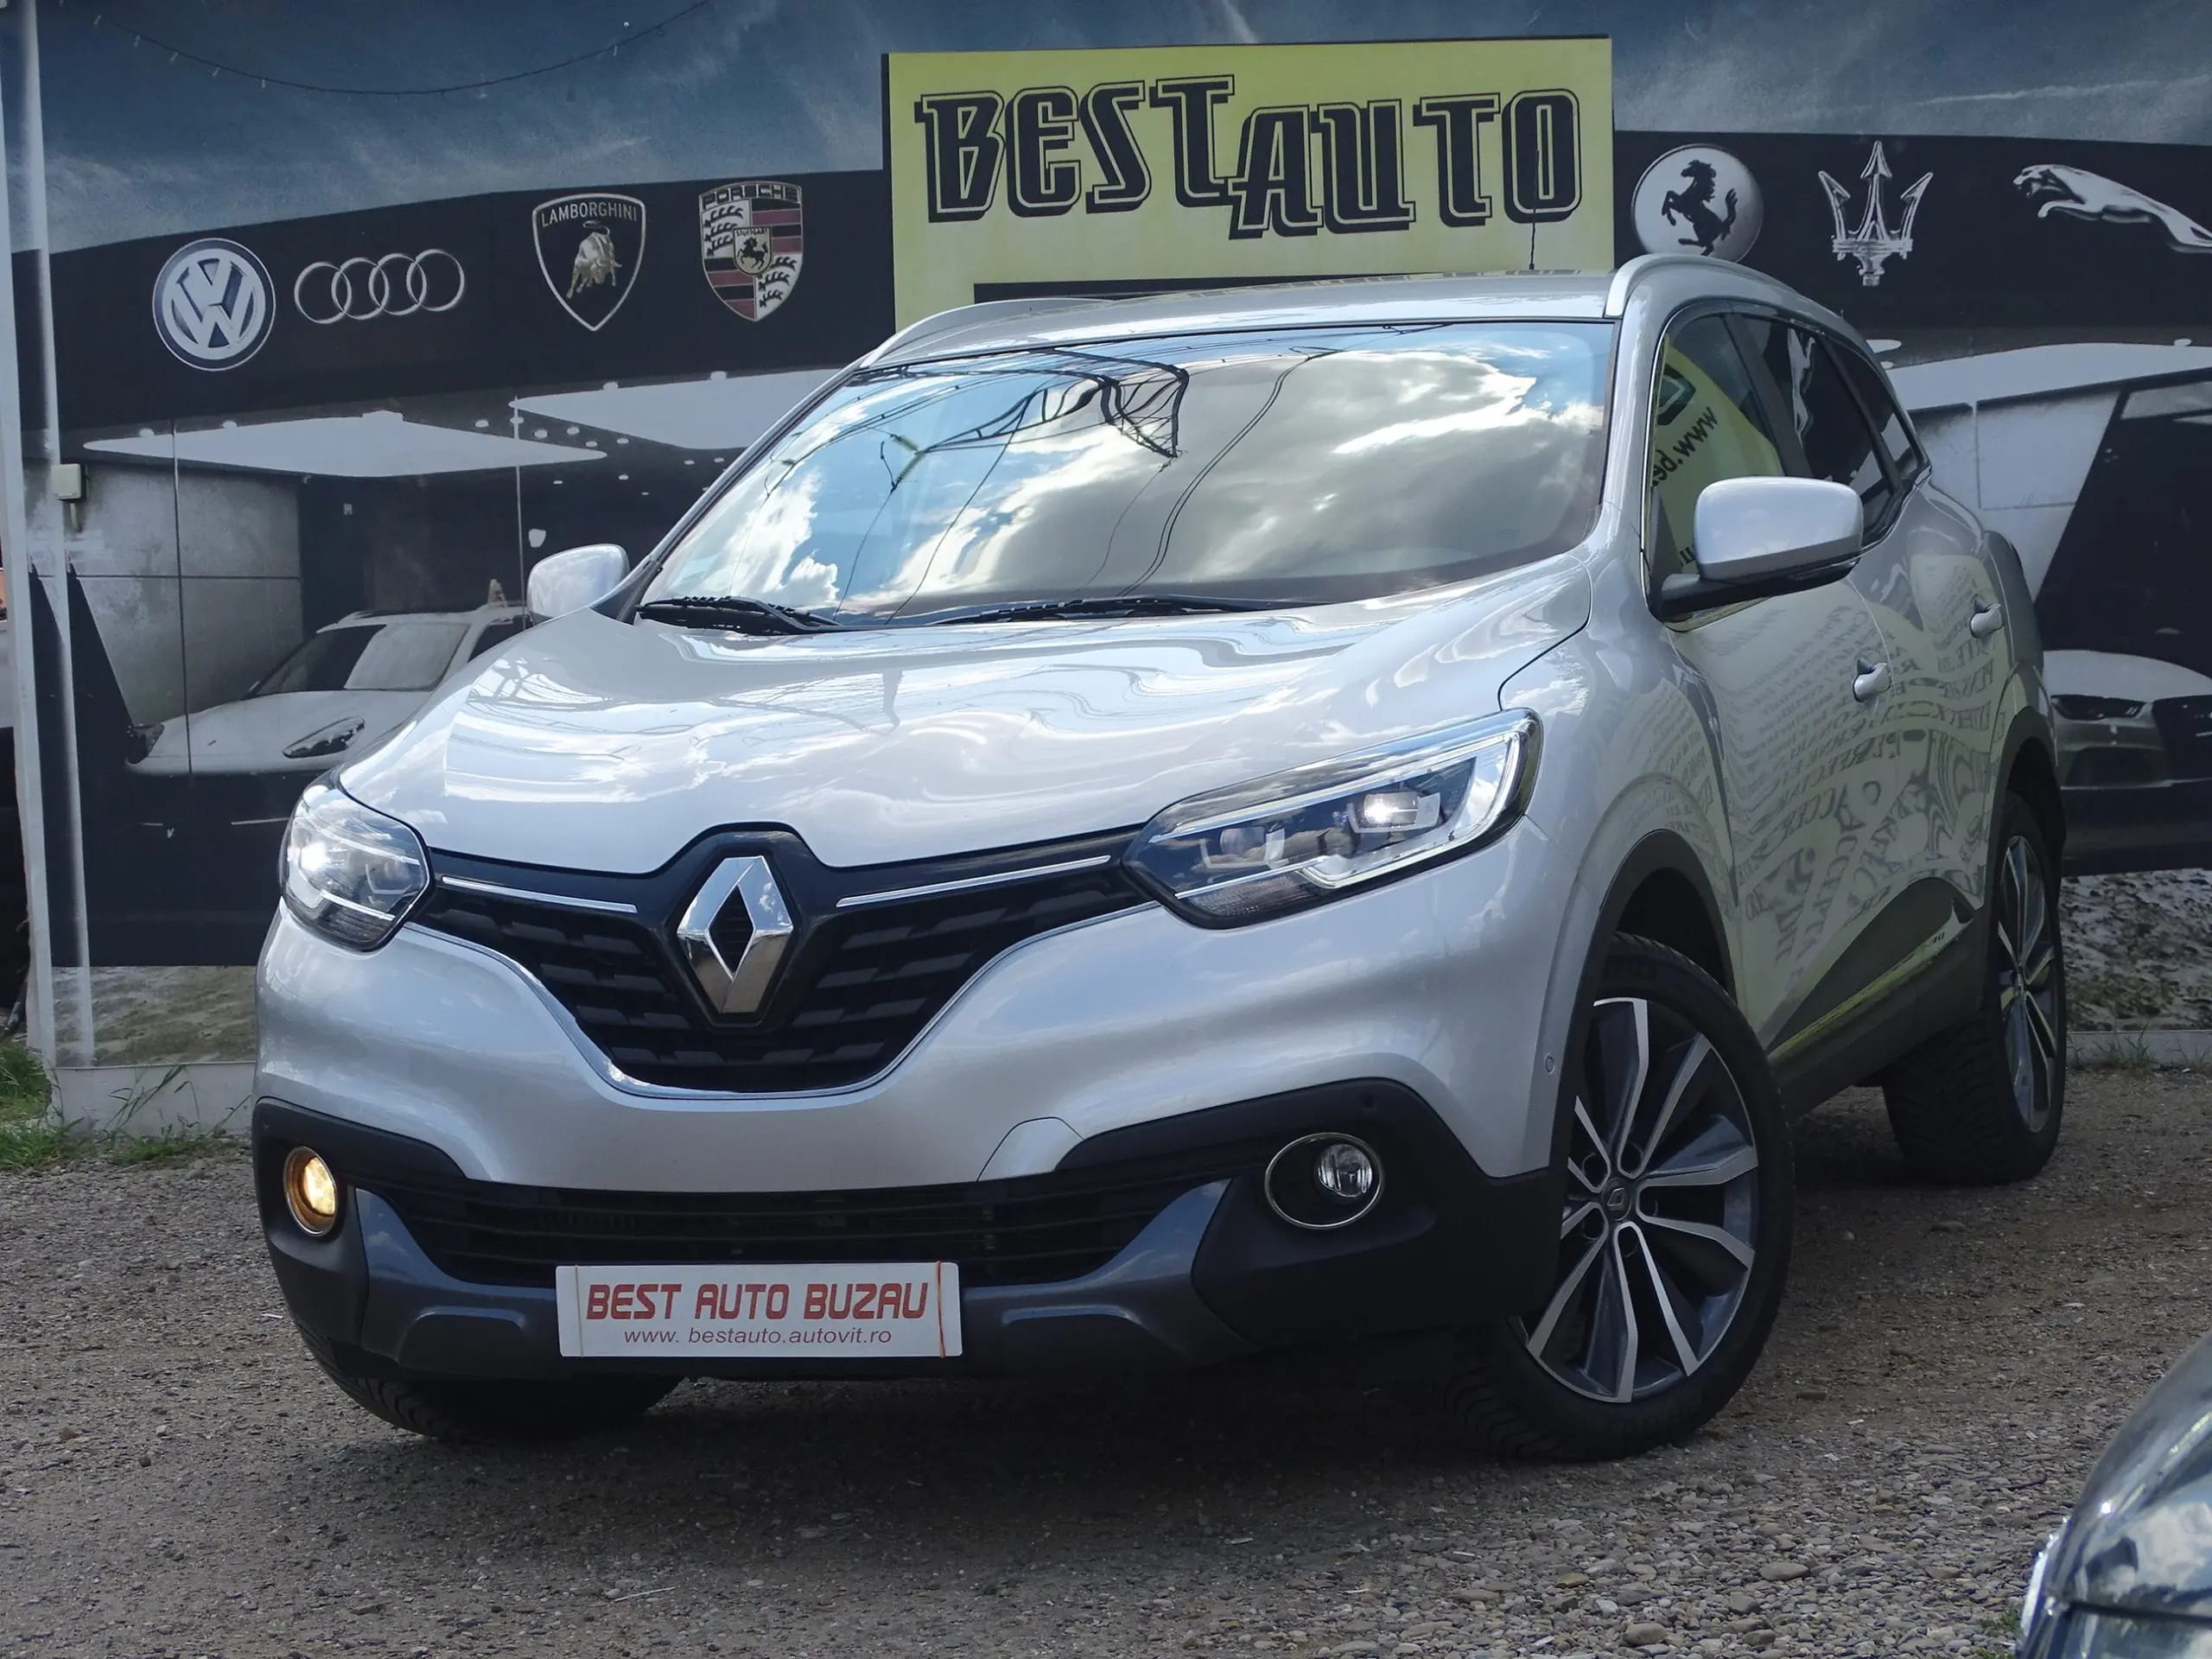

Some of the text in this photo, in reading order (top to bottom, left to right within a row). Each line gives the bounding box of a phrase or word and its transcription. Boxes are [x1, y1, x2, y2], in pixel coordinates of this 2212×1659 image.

[541, 201, 637, 228] LAMBORGHINI
[586, 1282, 929, 1320] BEST AUTO BUZAU
